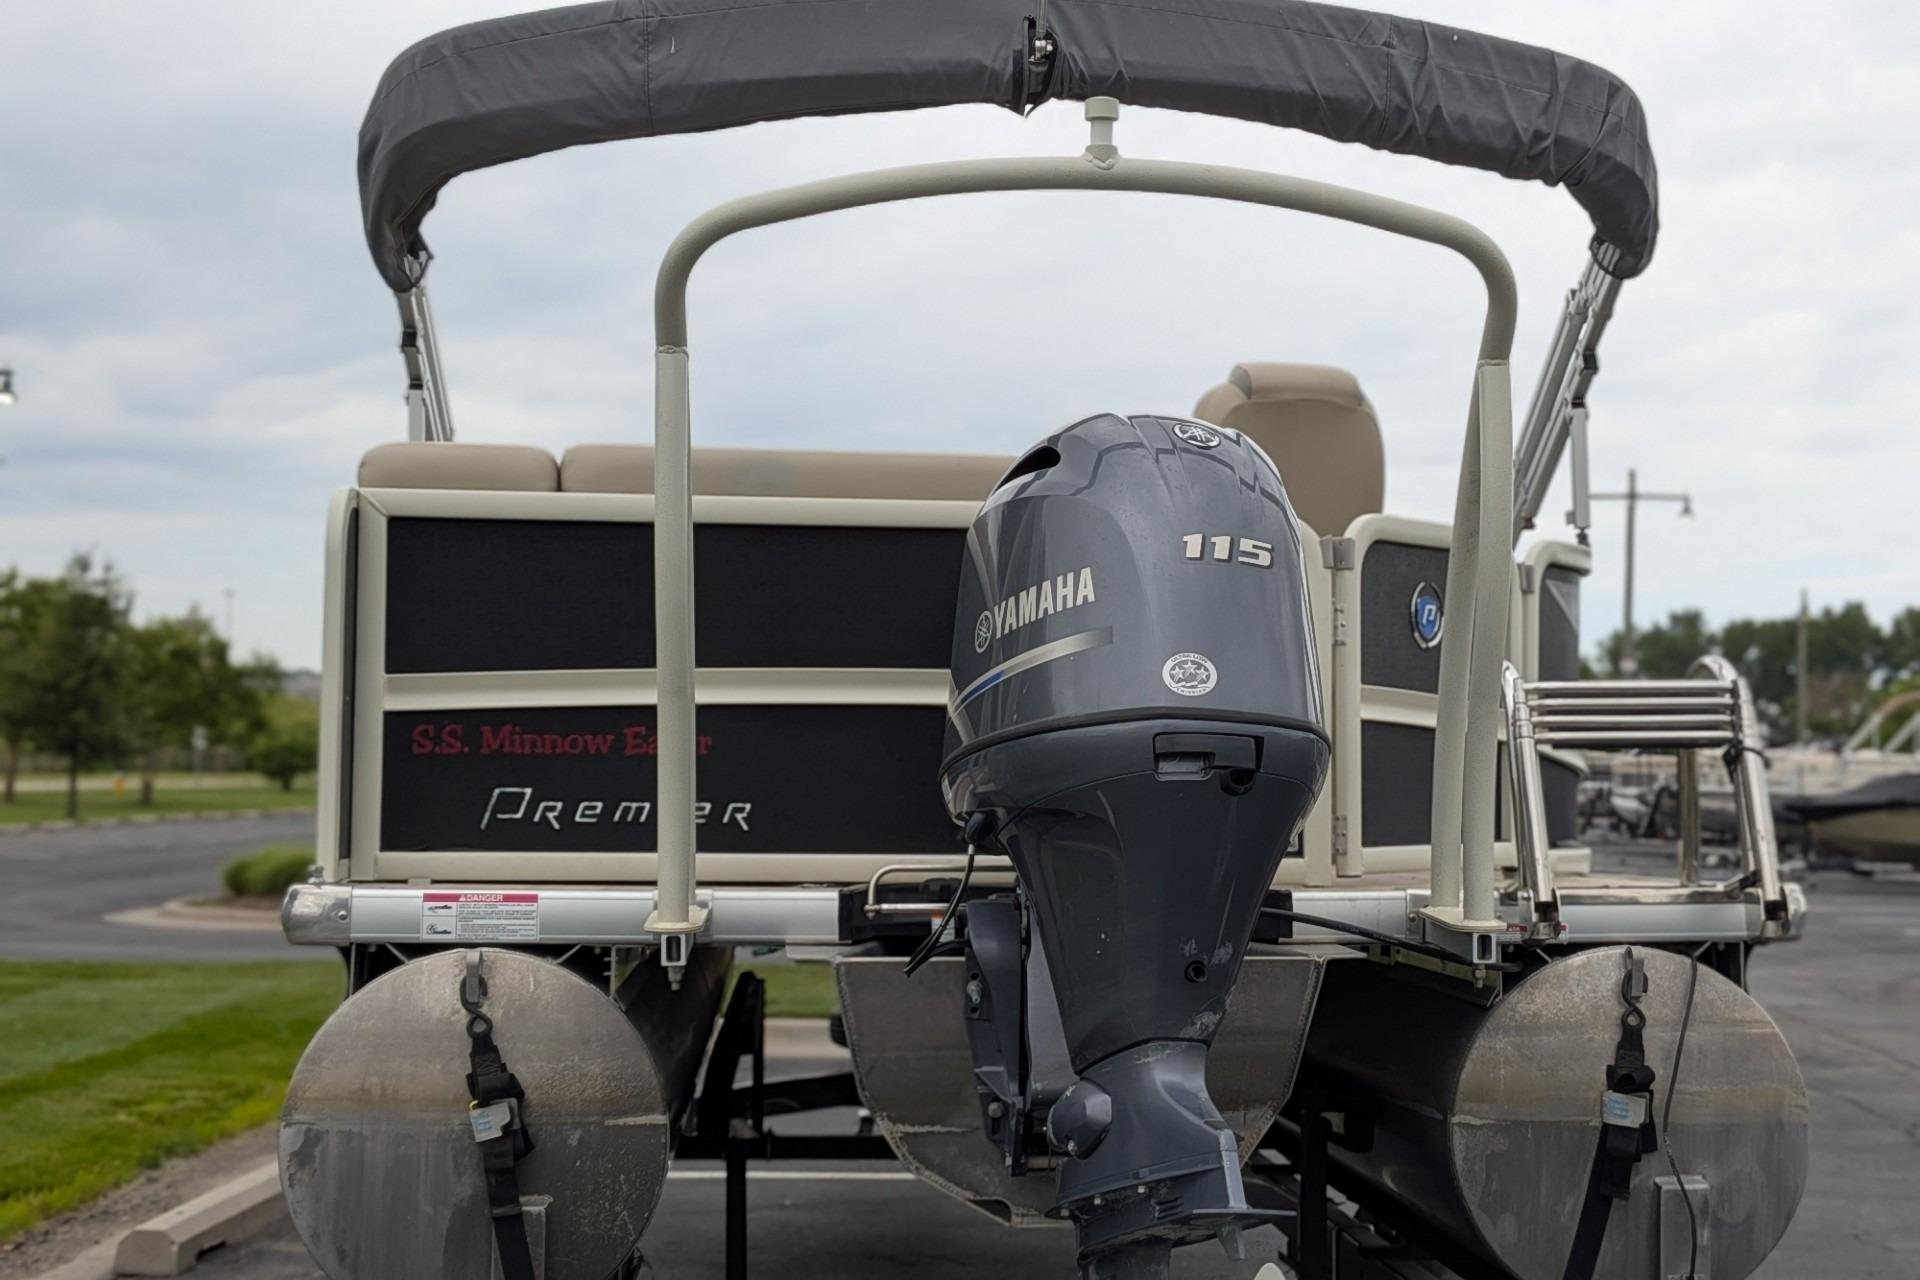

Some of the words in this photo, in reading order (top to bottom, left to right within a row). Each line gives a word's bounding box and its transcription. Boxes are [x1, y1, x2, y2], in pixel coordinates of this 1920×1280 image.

[1182, 533, 1273, 568] 115
[993, 566, 1096, 640] YAMAHA
[411, 724, 469, 753] S.S.
[479, 724, 615, 754] Minnow
[623, 726, 713, 757] Ear
[466, 894, 504, 902] DANGER
